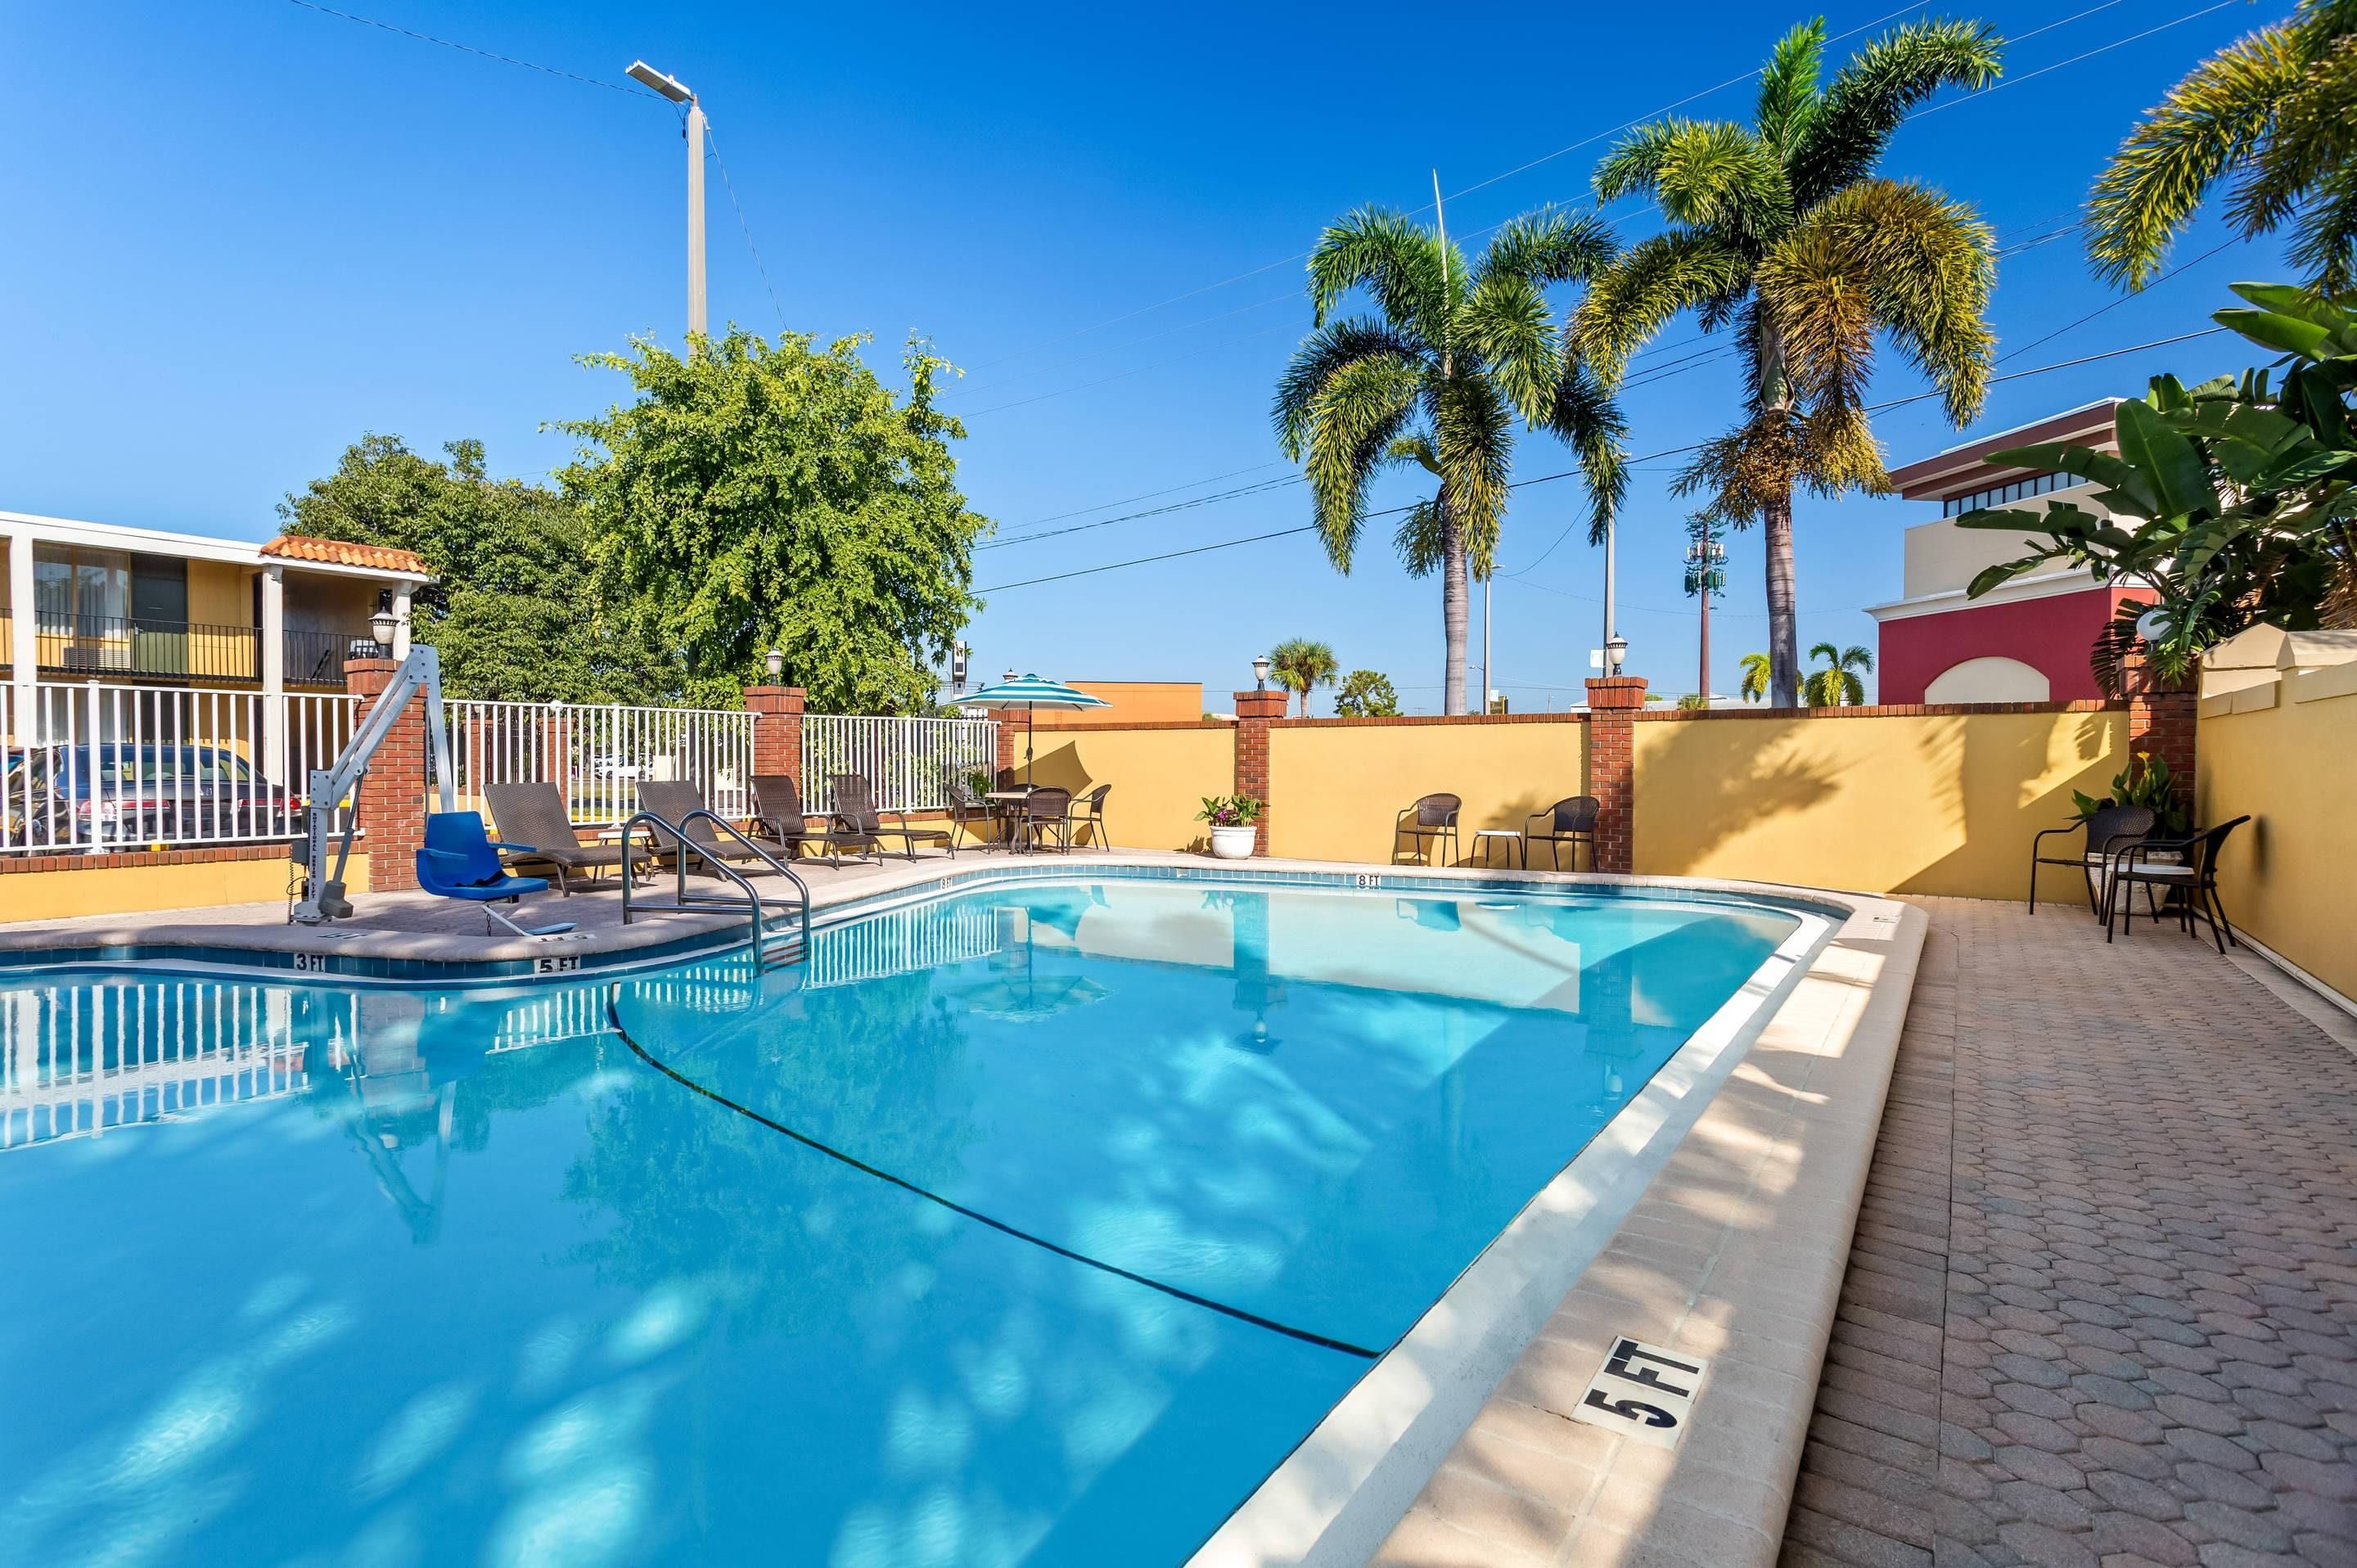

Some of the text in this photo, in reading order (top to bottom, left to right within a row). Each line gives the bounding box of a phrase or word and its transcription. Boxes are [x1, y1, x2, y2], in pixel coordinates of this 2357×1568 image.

[1359, 875, 1380, 885] 8 FT
[296, 953, 308, 971] 3
[540, 956, 579, 973] 5 FT
[1584, 1339, 1700, 1428] 5 FT
